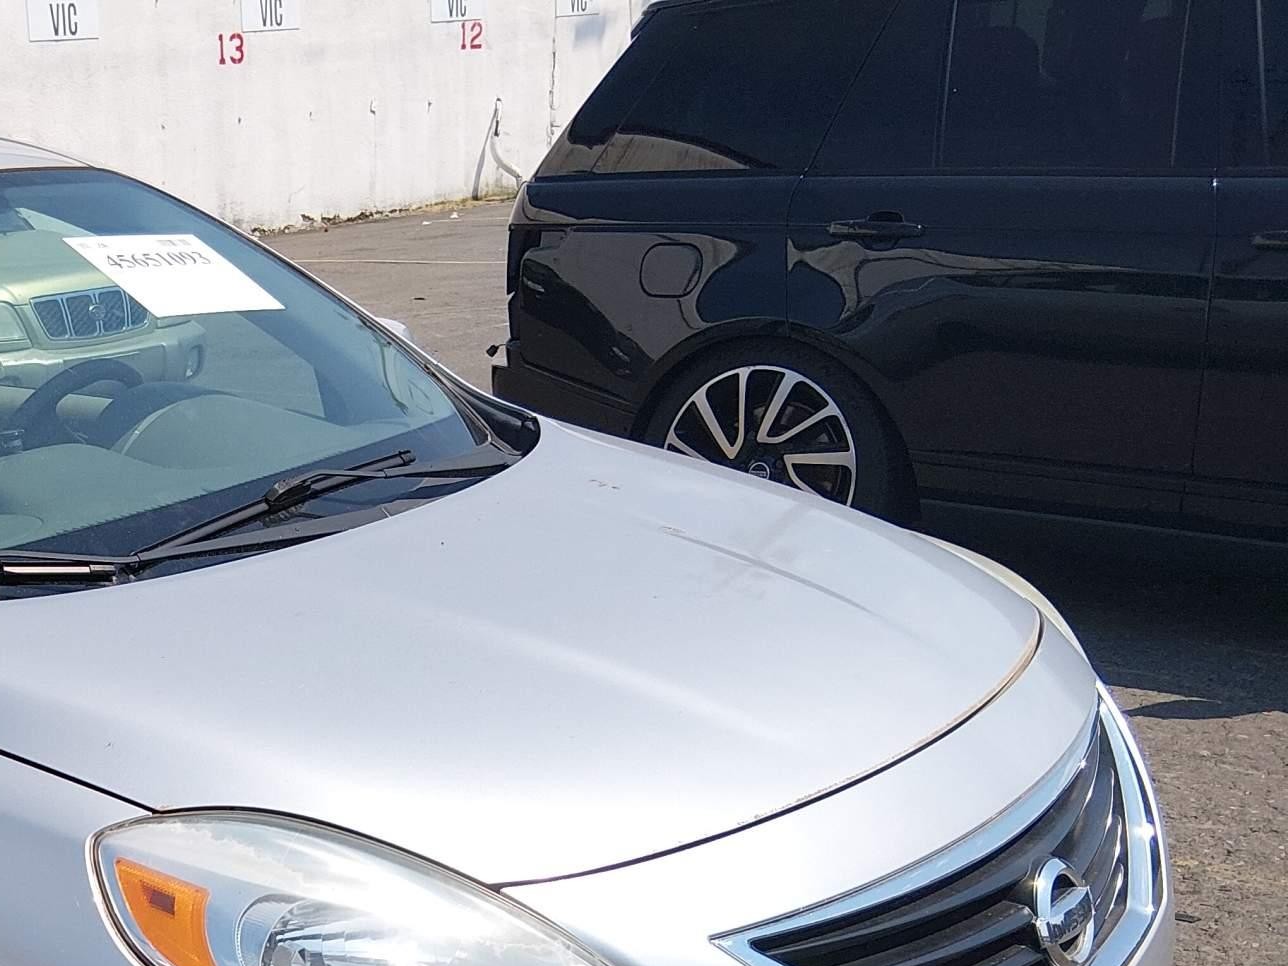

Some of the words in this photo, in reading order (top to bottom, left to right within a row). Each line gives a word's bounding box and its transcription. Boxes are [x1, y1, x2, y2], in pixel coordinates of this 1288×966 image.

[50, 3, 78, 36] VIC
[260, 0, 283, 27] VIC
[218, 33, 245, 65] 13
[460, 21, 483, 50] 12
[106, 250, 212, 270] 45651093
